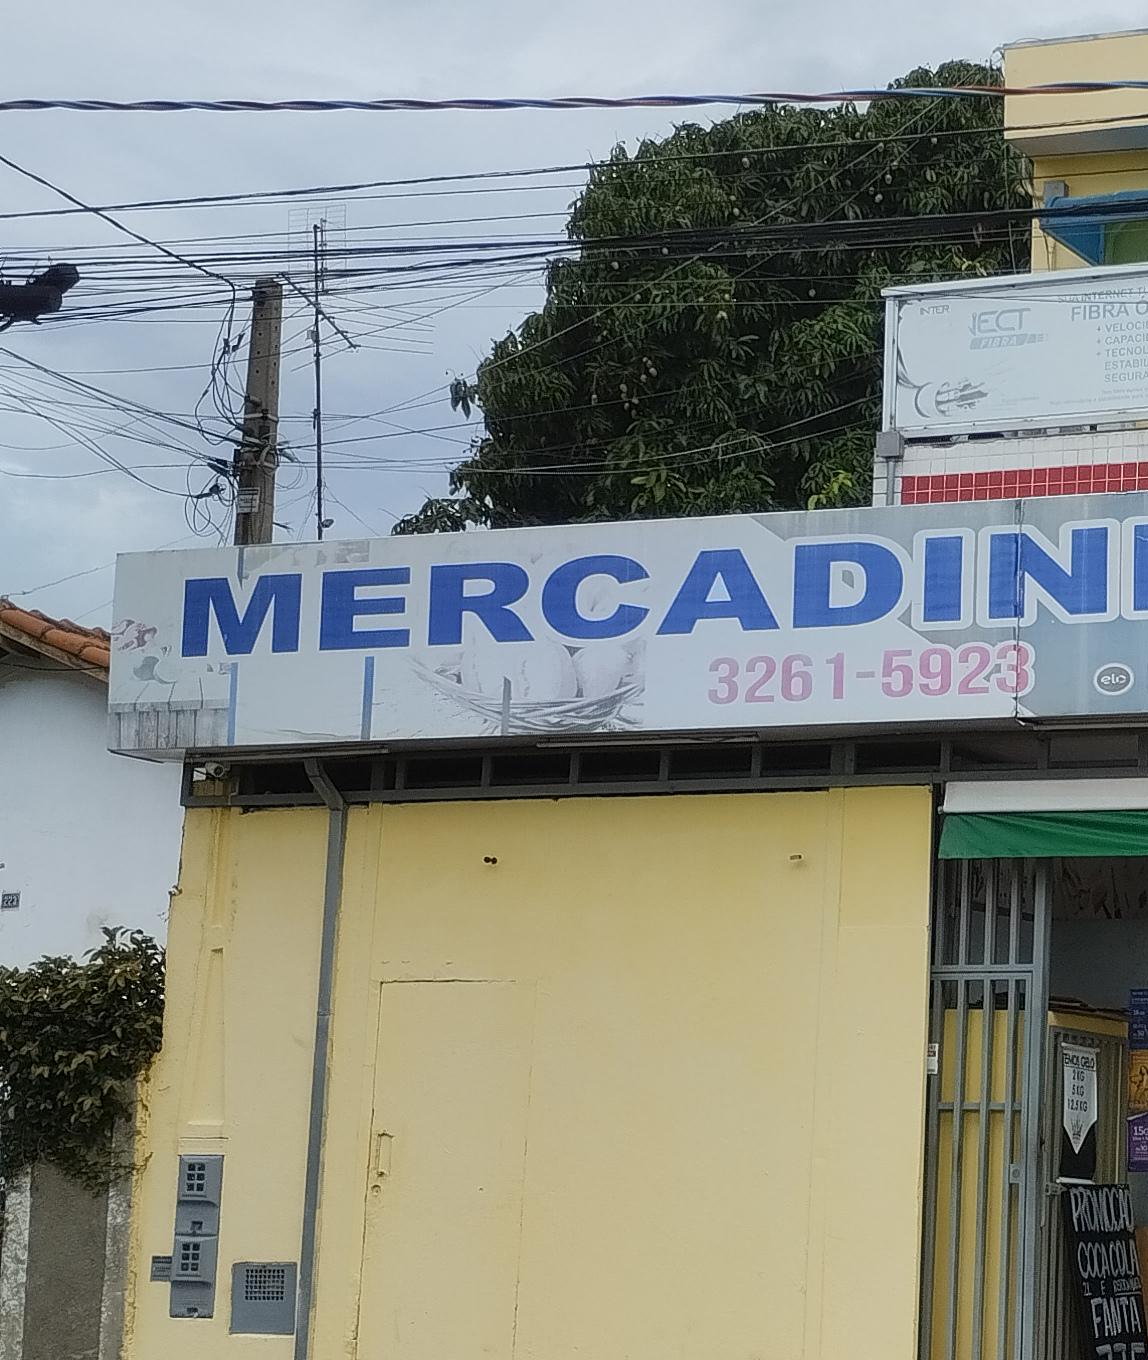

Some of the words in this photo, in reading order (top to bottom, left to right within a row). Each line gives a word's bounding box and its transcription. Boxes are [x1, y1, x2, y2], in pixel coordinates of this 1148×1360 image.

[1082, 288, 1135, 302] INTERNET
[1071, 303, 1129, 322] FIBRA
[708, 643, 1033, 705] 3261-5923
[1100, 673, 1128, 685] elo
[1091, 1296, 1142, 1339] FANTA
